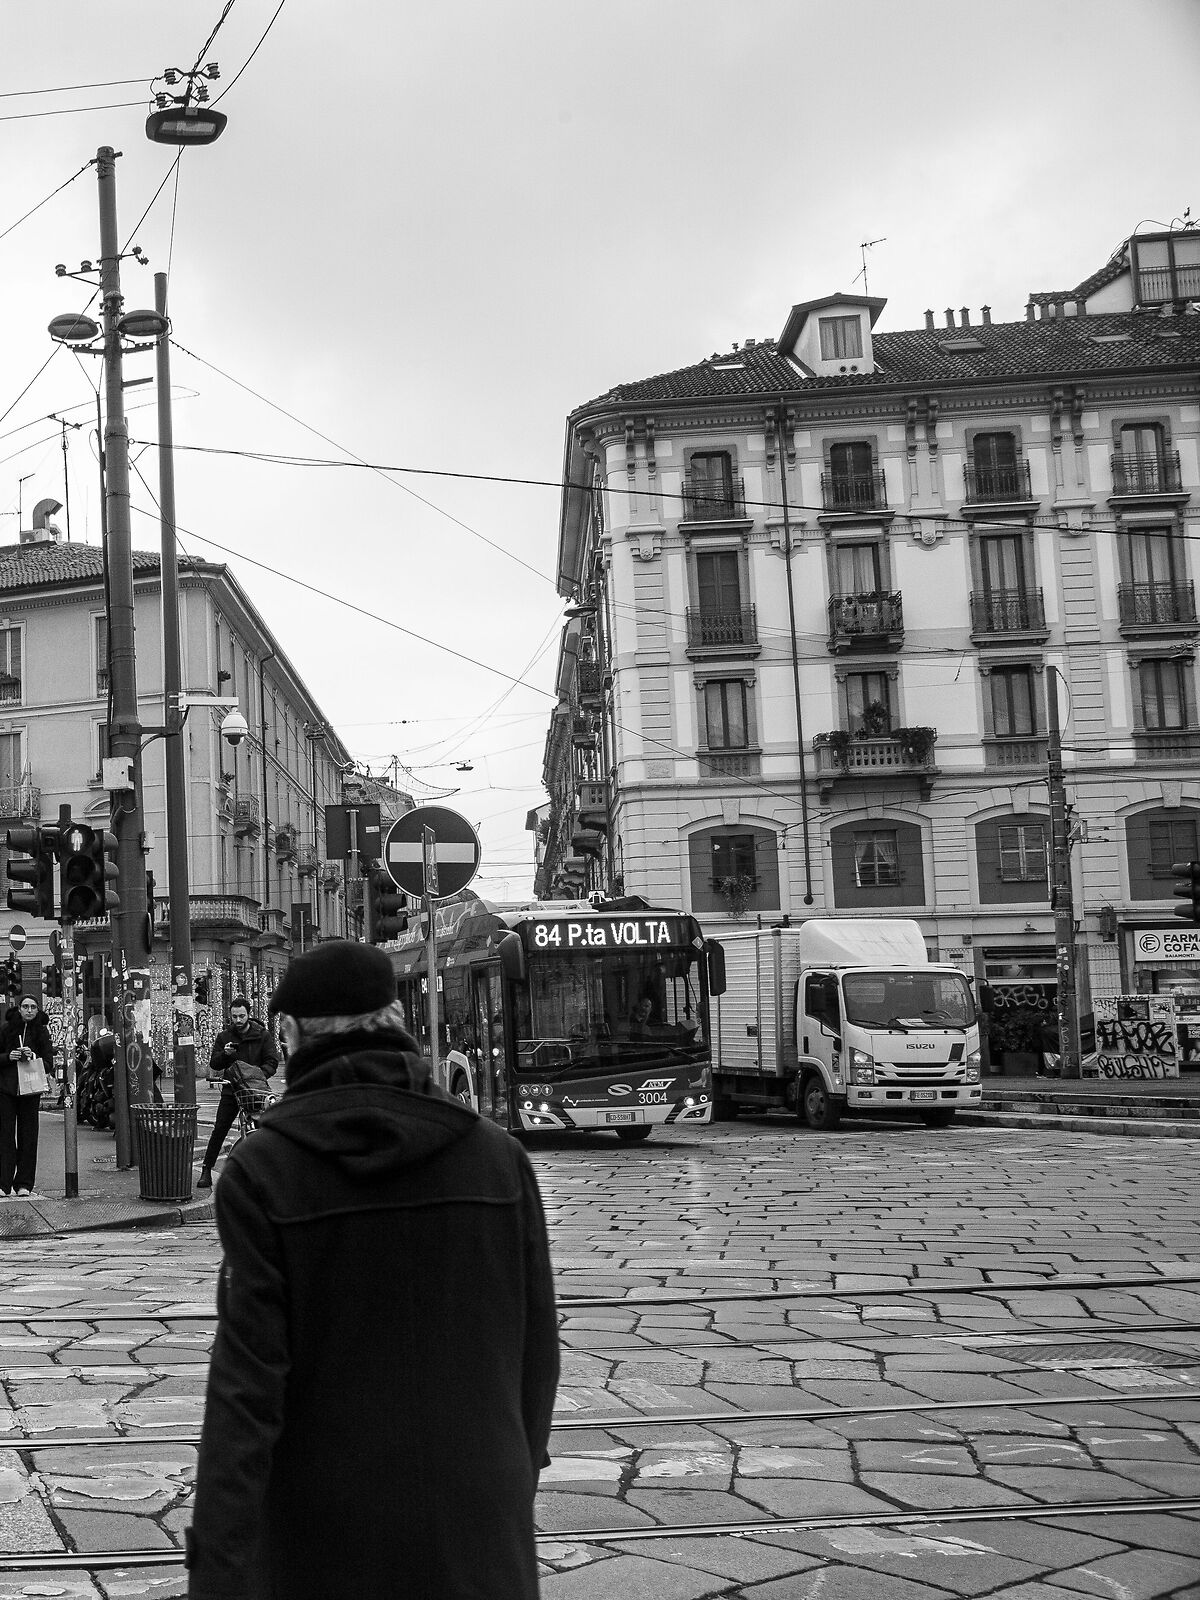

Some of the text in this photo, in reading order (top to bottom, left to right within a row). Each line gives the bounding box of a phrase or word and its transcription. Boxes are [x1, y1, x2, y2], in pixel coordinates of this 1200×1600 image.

[535, 921, 671, 947] 84 P.ta VOLTA
[1163, 933, 1200, 943] FARM
[648, 1080, 664, 1088] ATM
[638, 1092, 668, 1104] 3004
